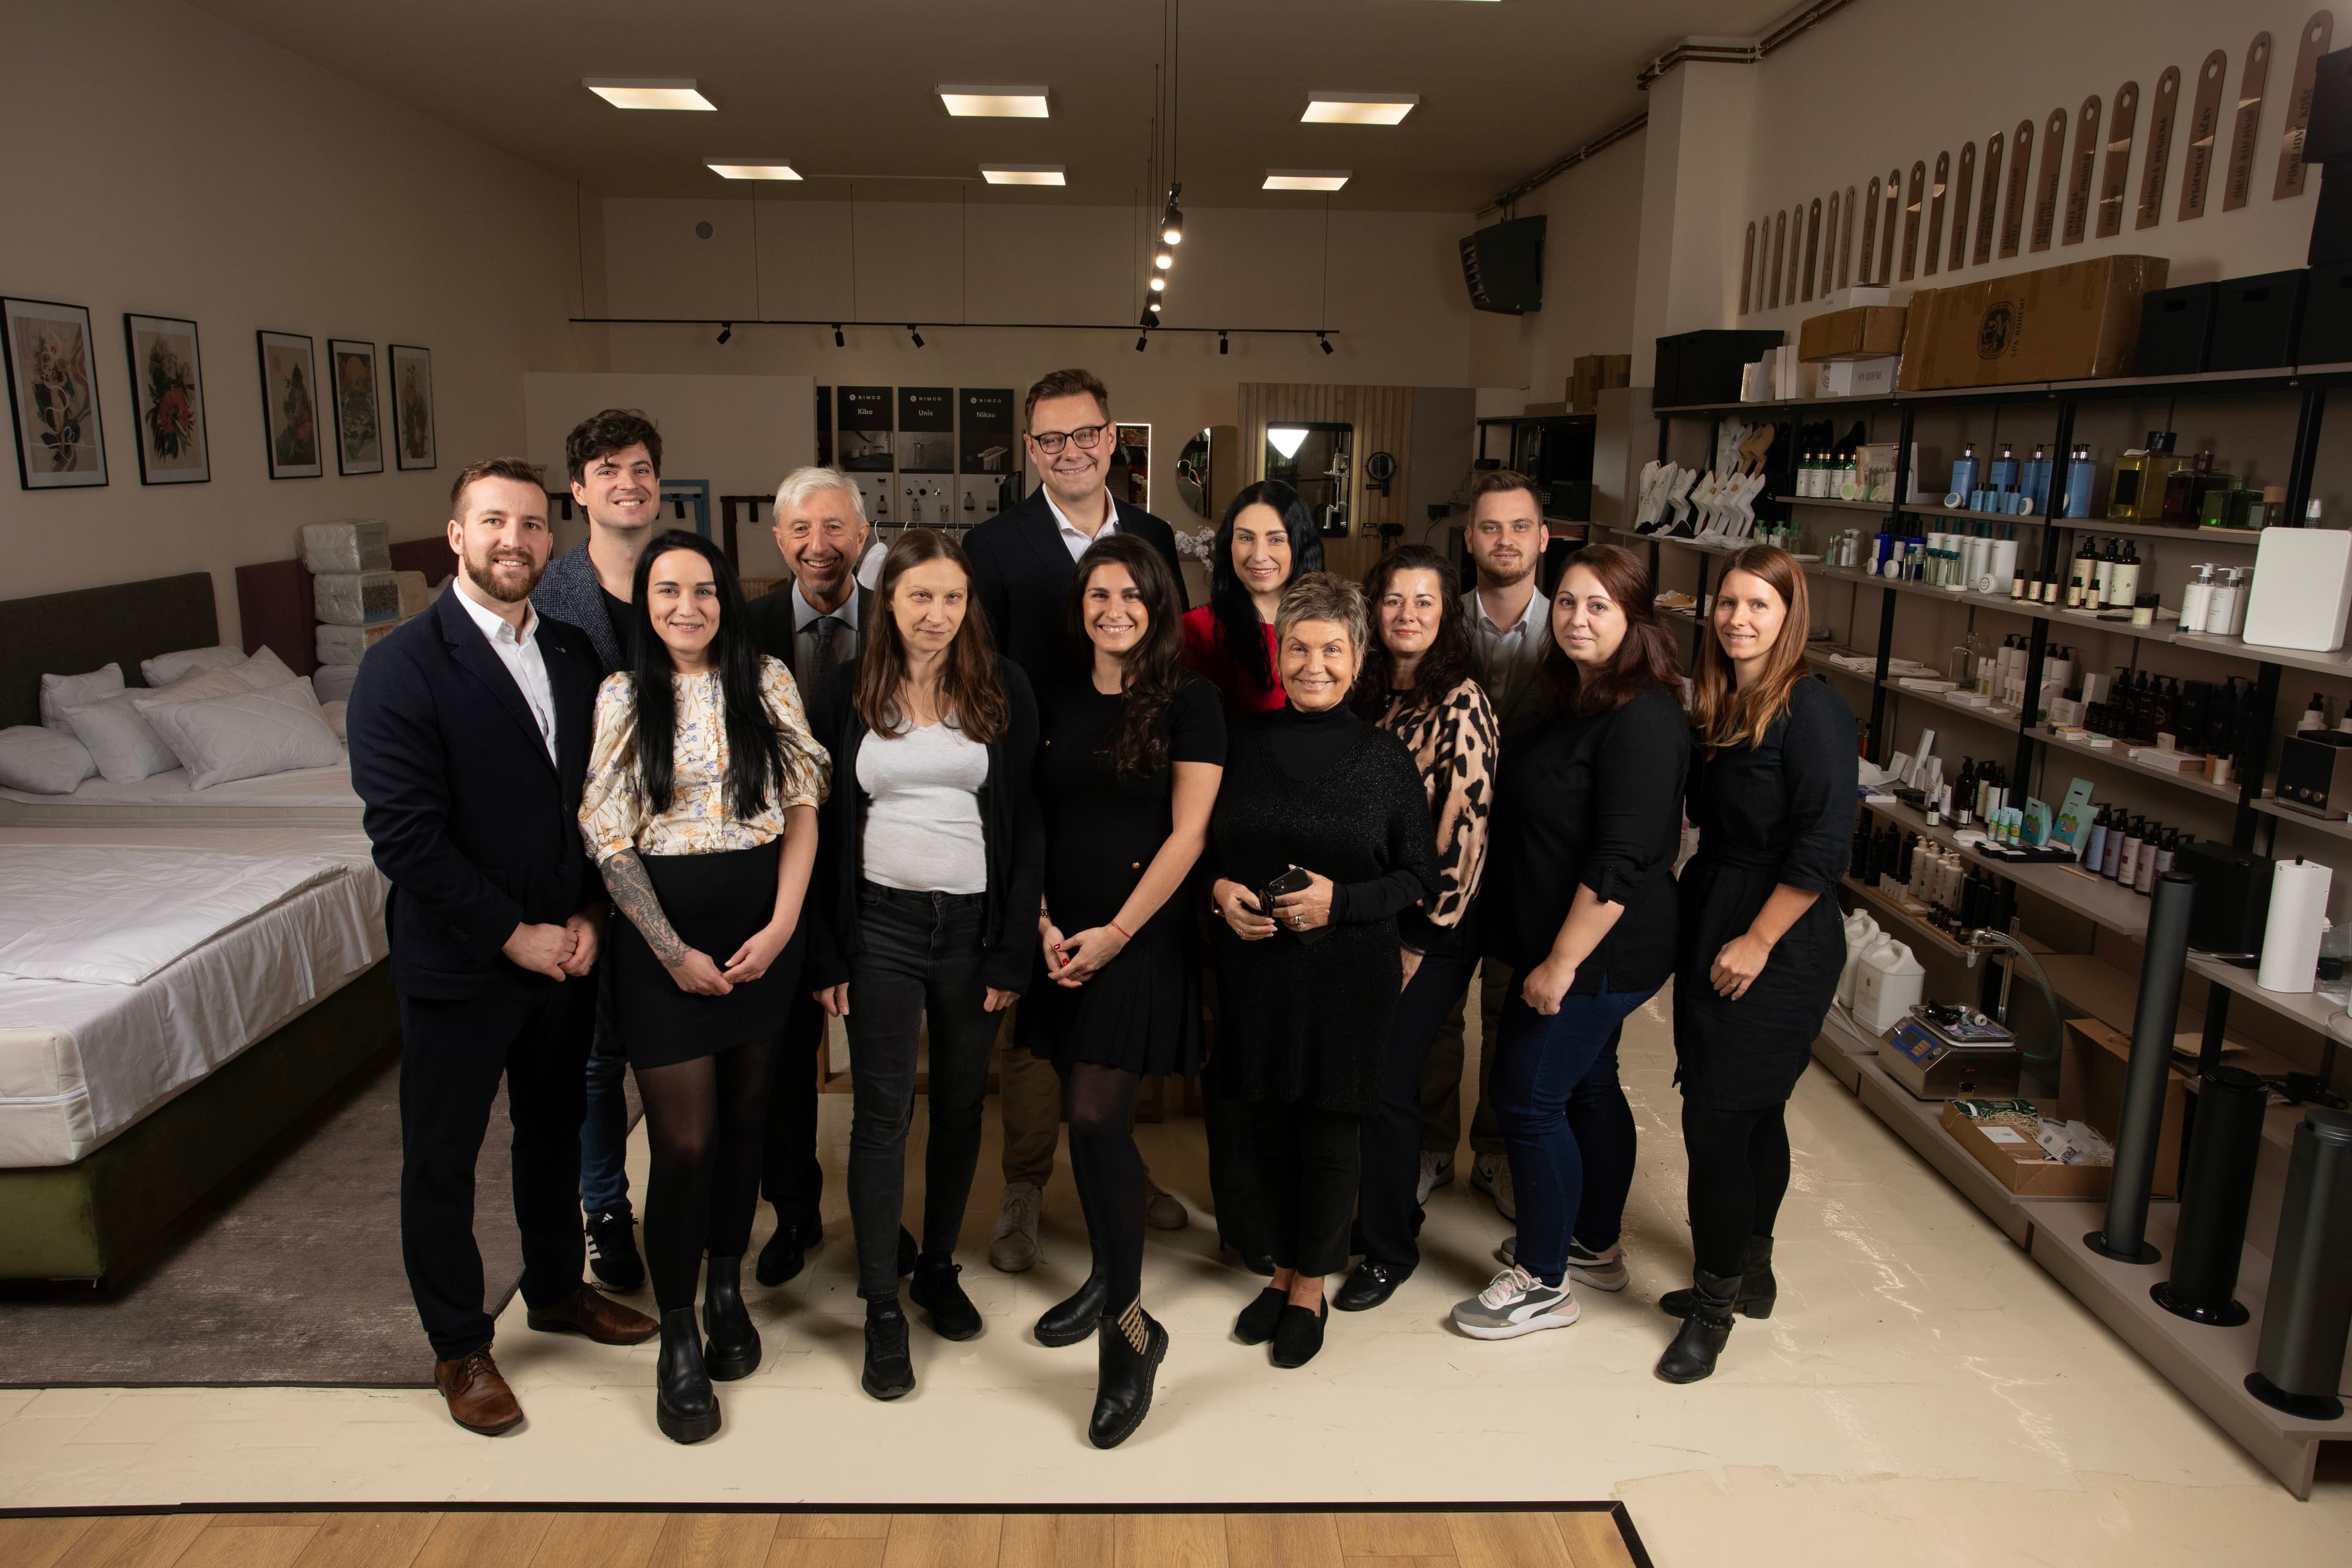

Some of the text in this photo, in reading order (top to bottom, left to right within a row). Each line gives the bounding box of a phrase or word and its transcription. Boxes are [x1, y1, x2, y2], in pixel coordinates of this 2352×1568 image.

[2286, 124, 2306, 186] POKOJOVÉ
[2189, 146, 2205, 209] HYGIENICKÉ
[2010, 341, 2019, 358] SPA
[1866, 371, 1882, 381] BOHEME
